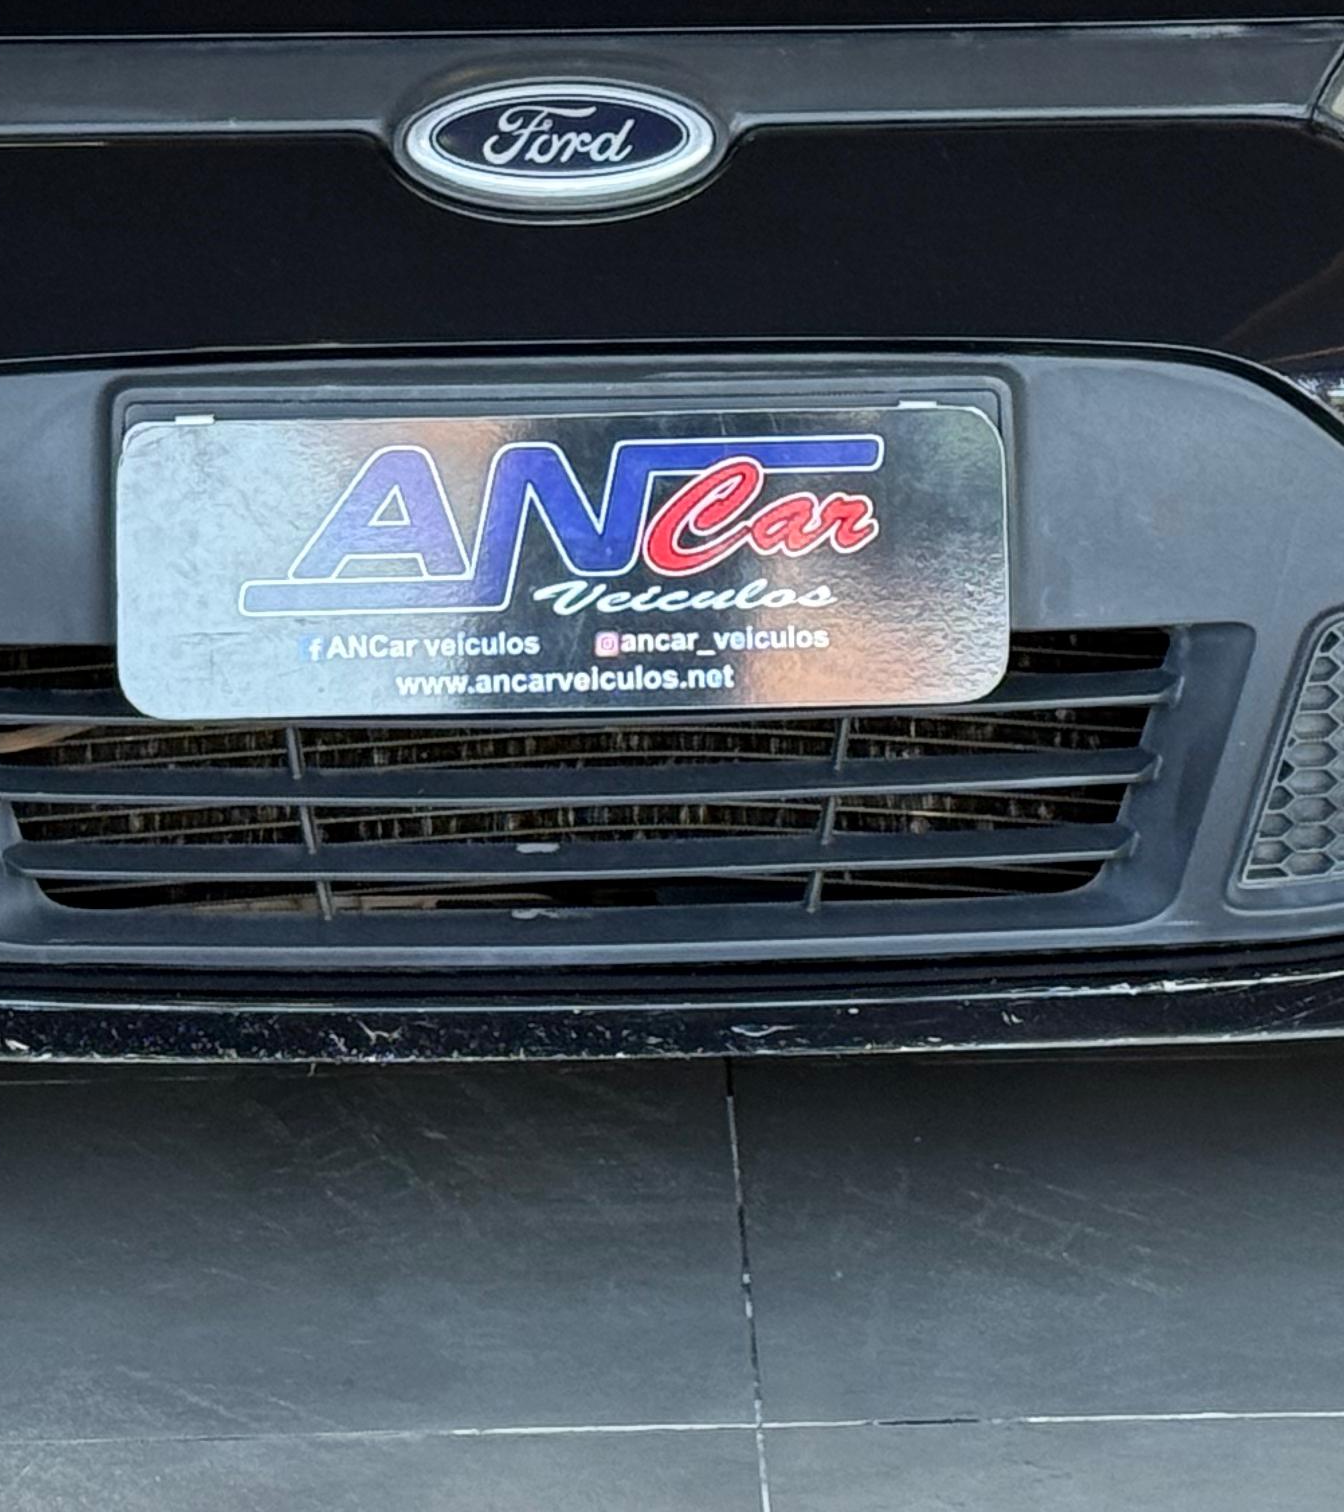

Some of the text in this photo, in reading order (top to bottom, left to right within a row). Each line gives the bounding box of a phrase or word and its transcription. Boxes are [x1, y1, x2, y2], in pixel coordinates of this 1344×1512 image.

[483, 106, 635, 164] Ford
[239, 434, 884, 616] AN Car
[326, 633, 419, 660] ANCar
[619, 624, 831, 657] ancar_veiculos
[395, 663, 736, 696] www.ancarveiculos.net
